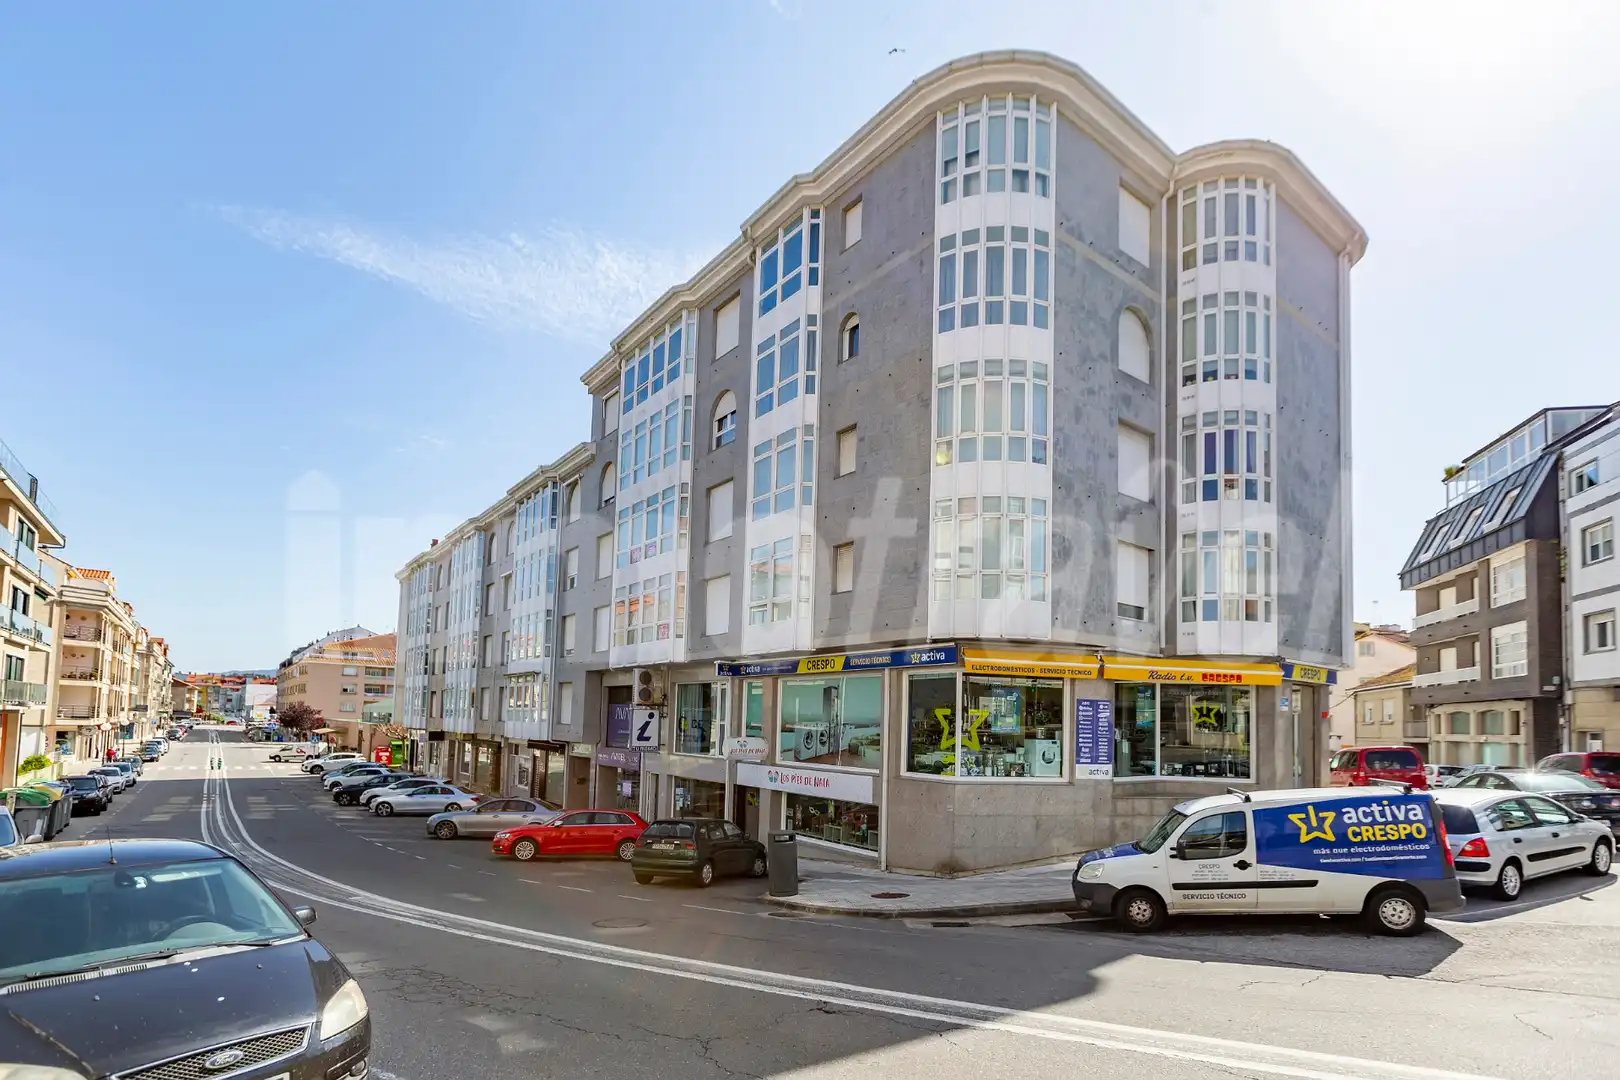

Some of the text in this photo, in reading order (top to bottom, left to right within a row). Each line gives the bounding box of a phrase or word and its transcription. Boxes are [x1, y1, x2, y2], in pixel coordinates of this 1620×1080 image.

[920, 650, 946, 662] activa
[806, 659, 836, 671] CRESPO
[850, 658, 871, 666] SERVICIO
[1039, 667, 1067, 675] SERVICIO
[1147, 670, 1177, 681] Radio
[1300, 667, 1321, 681] CRESPO
[1201, 673, 1243, 684] CRESPO
[1088, 768, 1110, 776] activa
[804, 776, 813, 786] DE
[1341, 800, 1424, 823] activa
[1347, 823, 1427, 842] CRESPO
[1350, 843, 1431, 854] electrodomésticos
[1216, 892, 1246, 900] TÉCNICO
